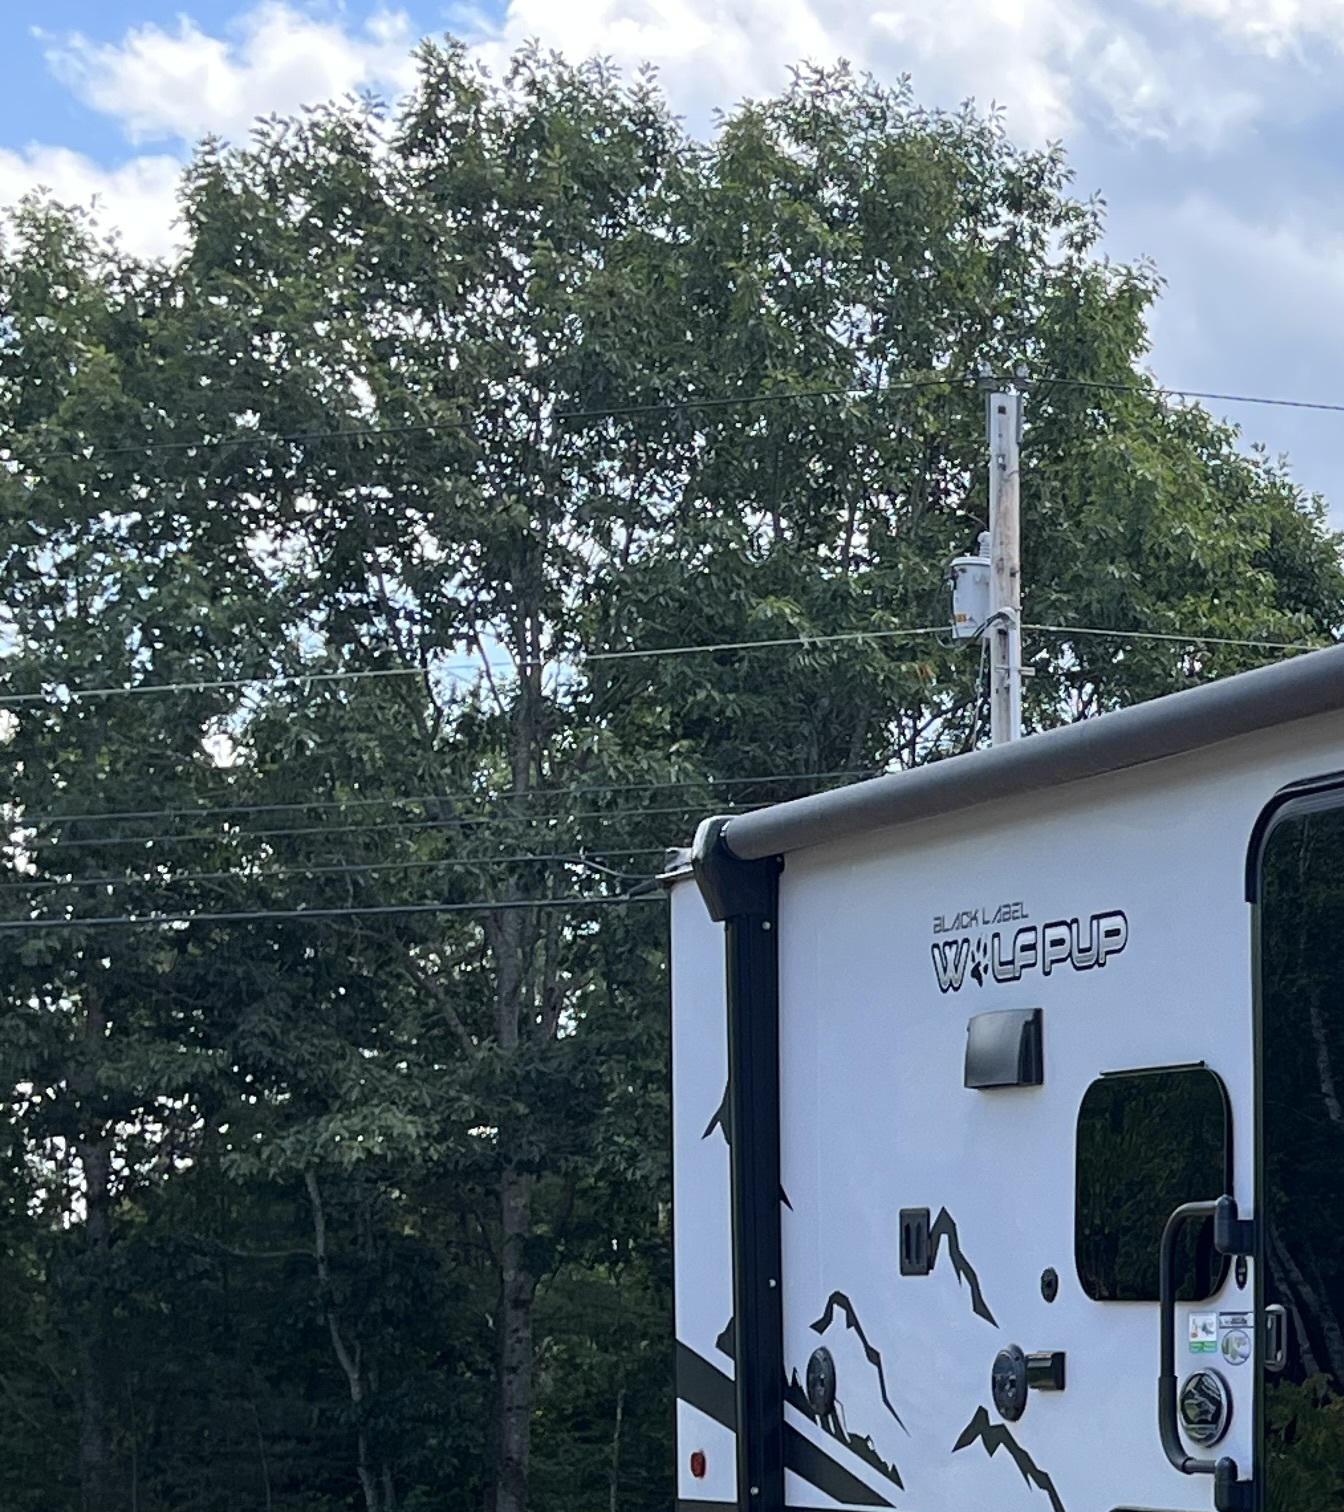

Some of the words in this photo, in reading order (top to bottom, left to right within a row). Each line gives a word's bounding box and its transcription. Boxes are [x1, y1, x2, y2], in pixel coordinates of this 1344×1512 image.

[933, 908, 979, 935] BLACK
[981, 901, 1029, 926] LABEL
[1042, 909, 1129, 977] PUP
